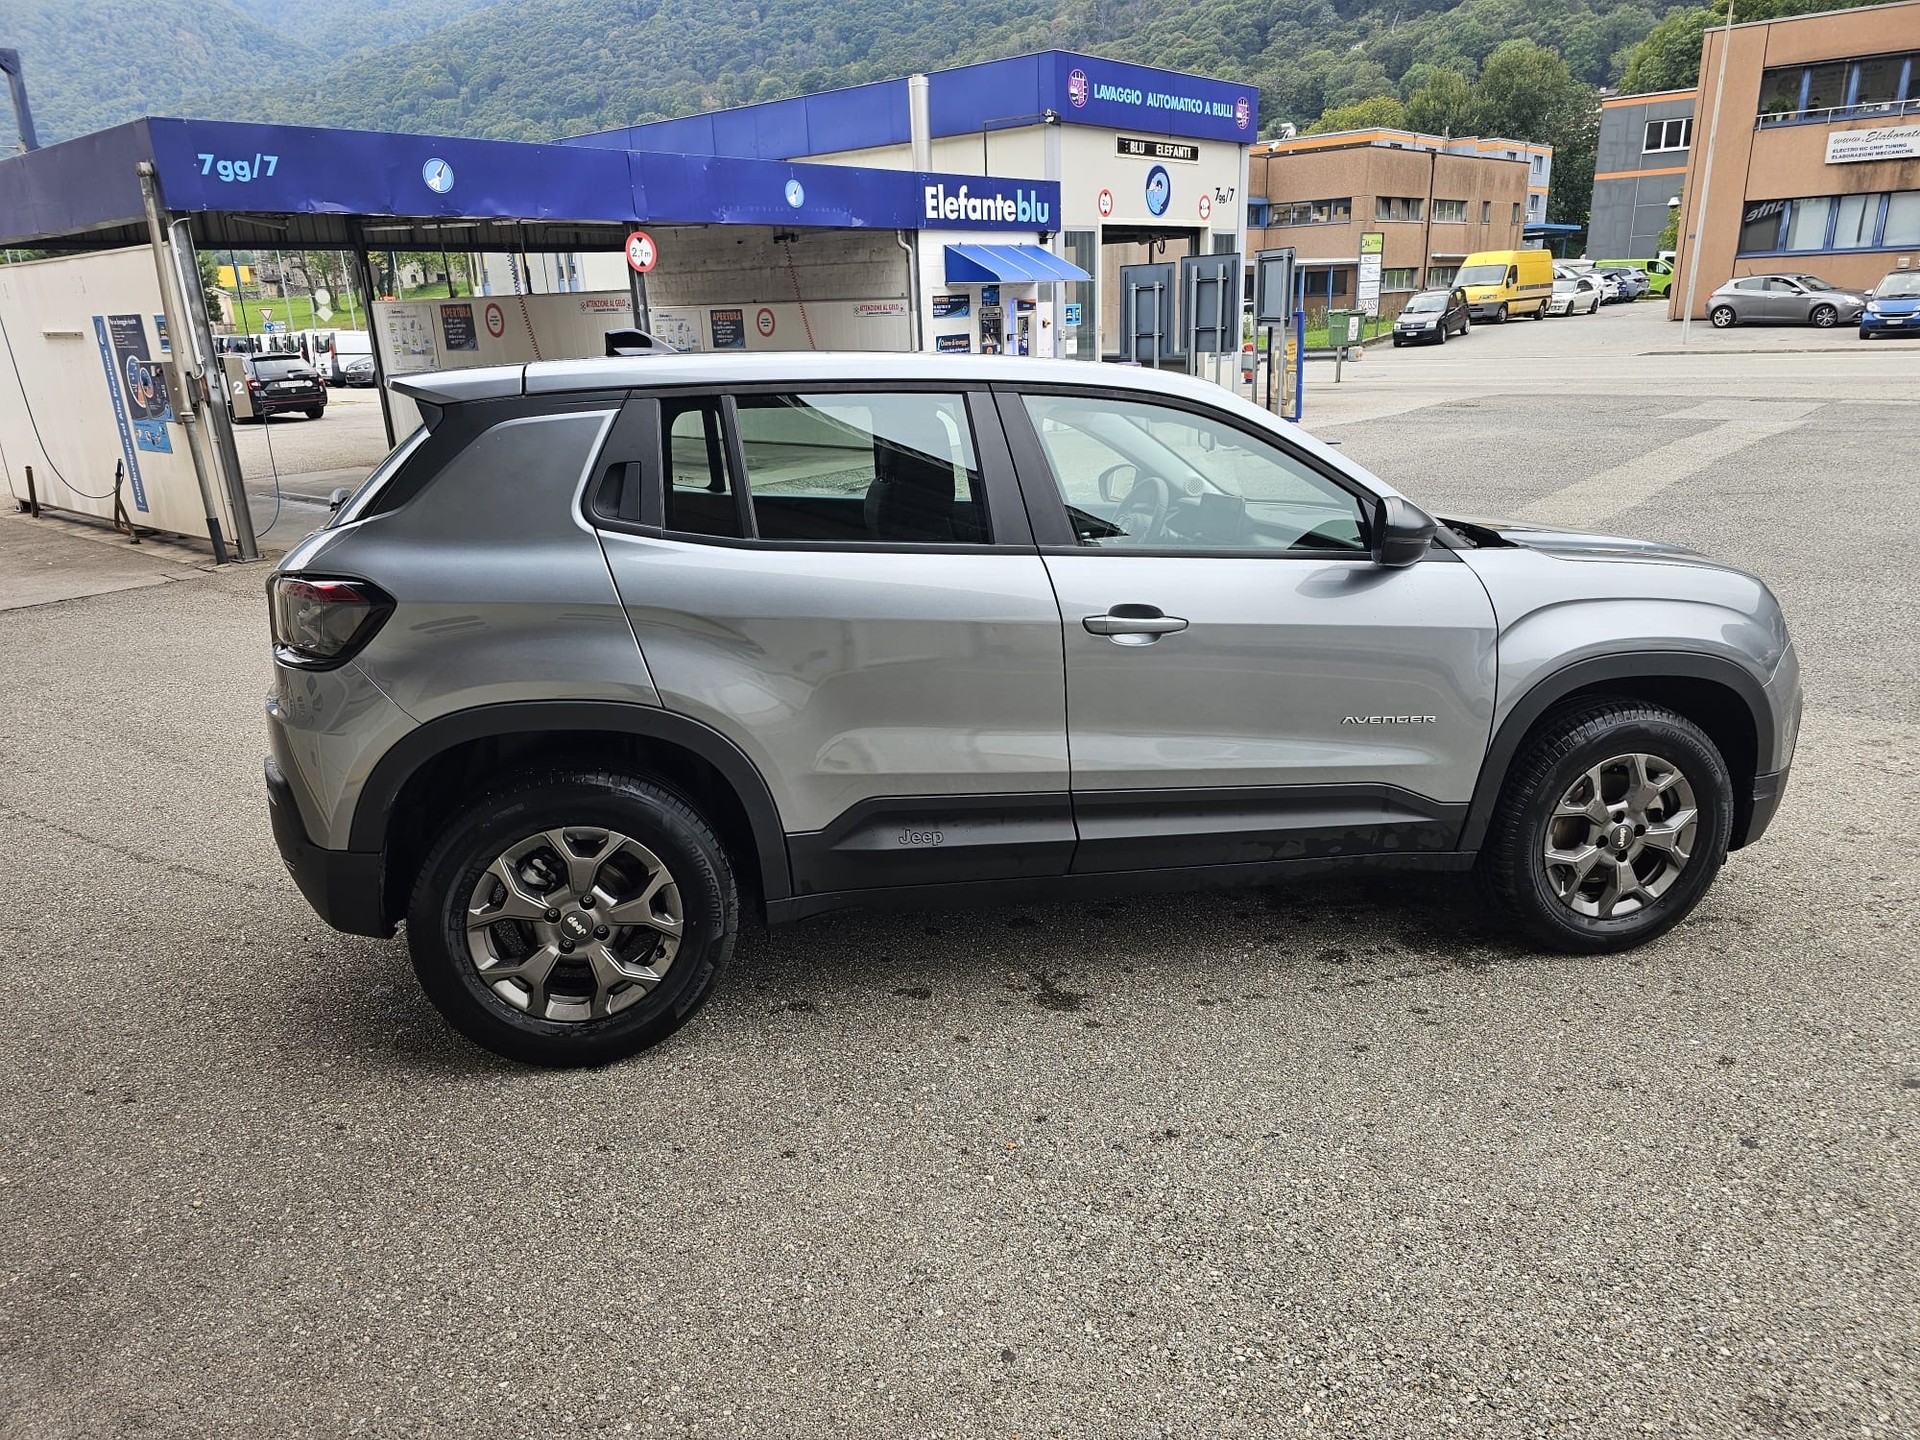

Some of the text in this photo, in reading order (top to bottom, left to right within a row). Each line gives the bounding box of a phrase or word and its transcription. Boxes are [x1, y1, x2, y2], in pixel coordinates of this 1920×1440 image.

[1093, 84, 1233, 118] LAVAGGIO AUTOMATICO A RULLI
[1130, 141, 1145, 154] BLU
[1831, 152, 1874, 160] ELABORAZIONI
[197, 153, 279, 182] 7gg/7
[924, 184, 1049, 224] Elefanteblu
[615, 299, 625, 307] GELO
[233, 381, 245, 395] 2
[1340, 714, 1437, 724] AVENGER
[898, 829, 945, 847] Jeep
[1617, 827, 1627, 848] Jeep
[566, 916, 587, 935] Jeep
